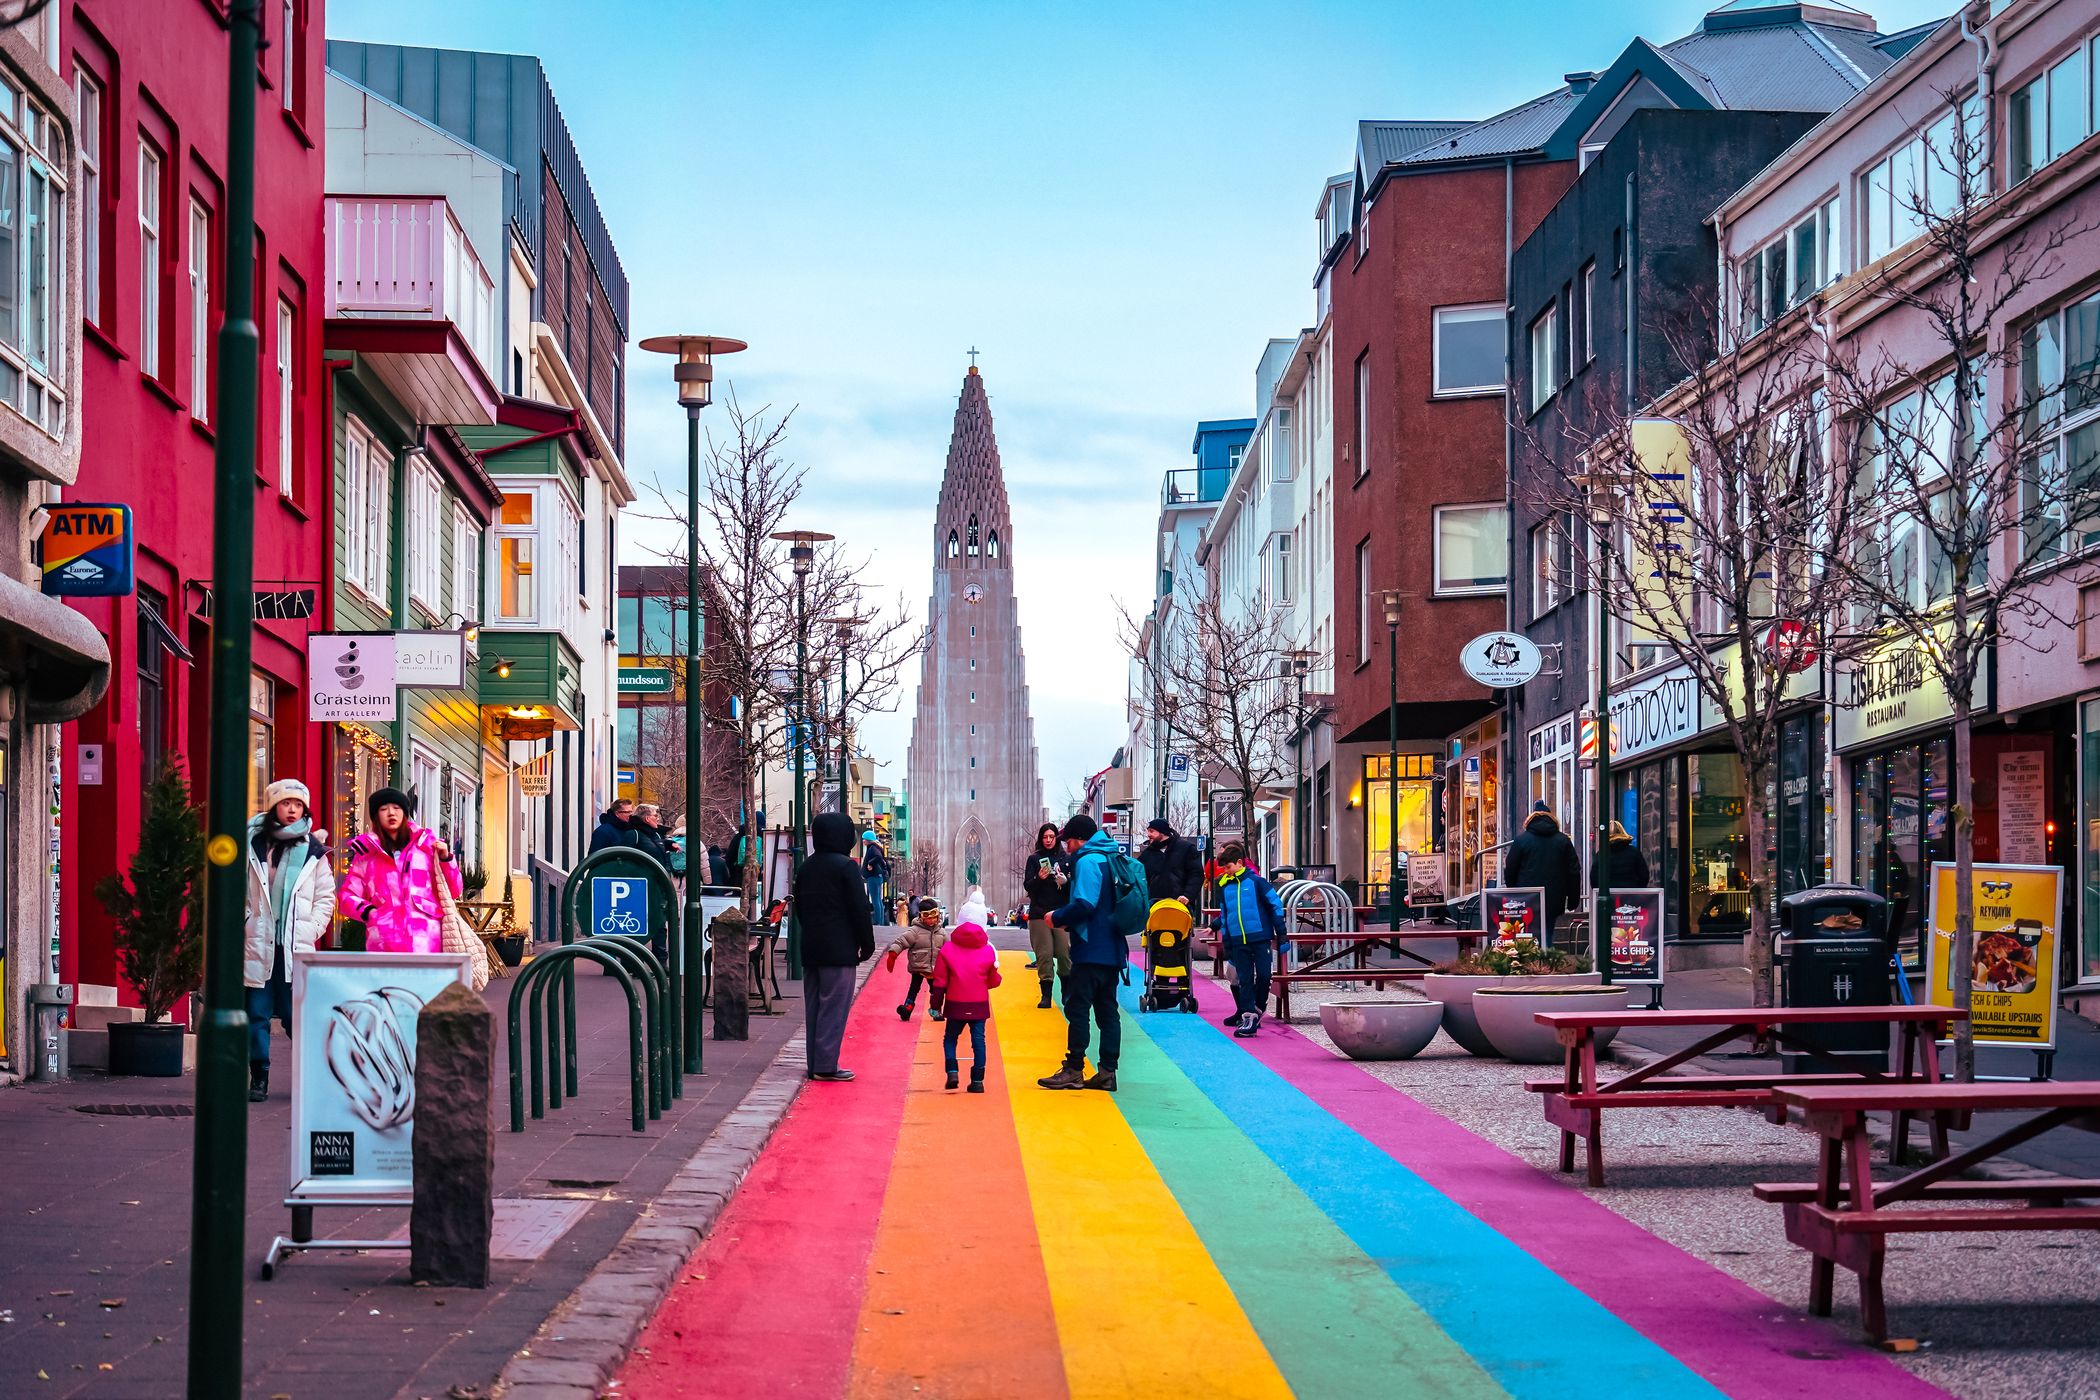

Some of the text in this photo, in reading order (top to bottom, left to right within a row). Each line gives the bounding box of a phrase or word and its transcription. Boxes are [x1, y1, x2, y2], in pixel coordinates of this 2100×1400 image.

[53, 513, 114, 535] ATM
[70, 565, 97, 573] Euronet
[1851, 663, 1874, 708] FISH
[1877, 662, 1886, 701] &
[314, 692, 391, 706] Grásteinn
[1866, 701, 1906, 727] RESTAURANT
[1784, 780, 1793, 796] FISH
[1796, 775, 1808, 793] CHIPS
[610, 881, 630, 907] P
[1980, 904, 2012, 919] REYKJAVÍK
[1622, 947, 1628, 955] &
[1630, 947, 1655, 955] CHIPS
[1993, 995, 2012, 1006] CHIPS
[2008, 1012, 2042, 1023] UPSTAIRS
[314, 1135, 350, 1146] ANNA
[314, 1146, 350, 1156] MARIA
